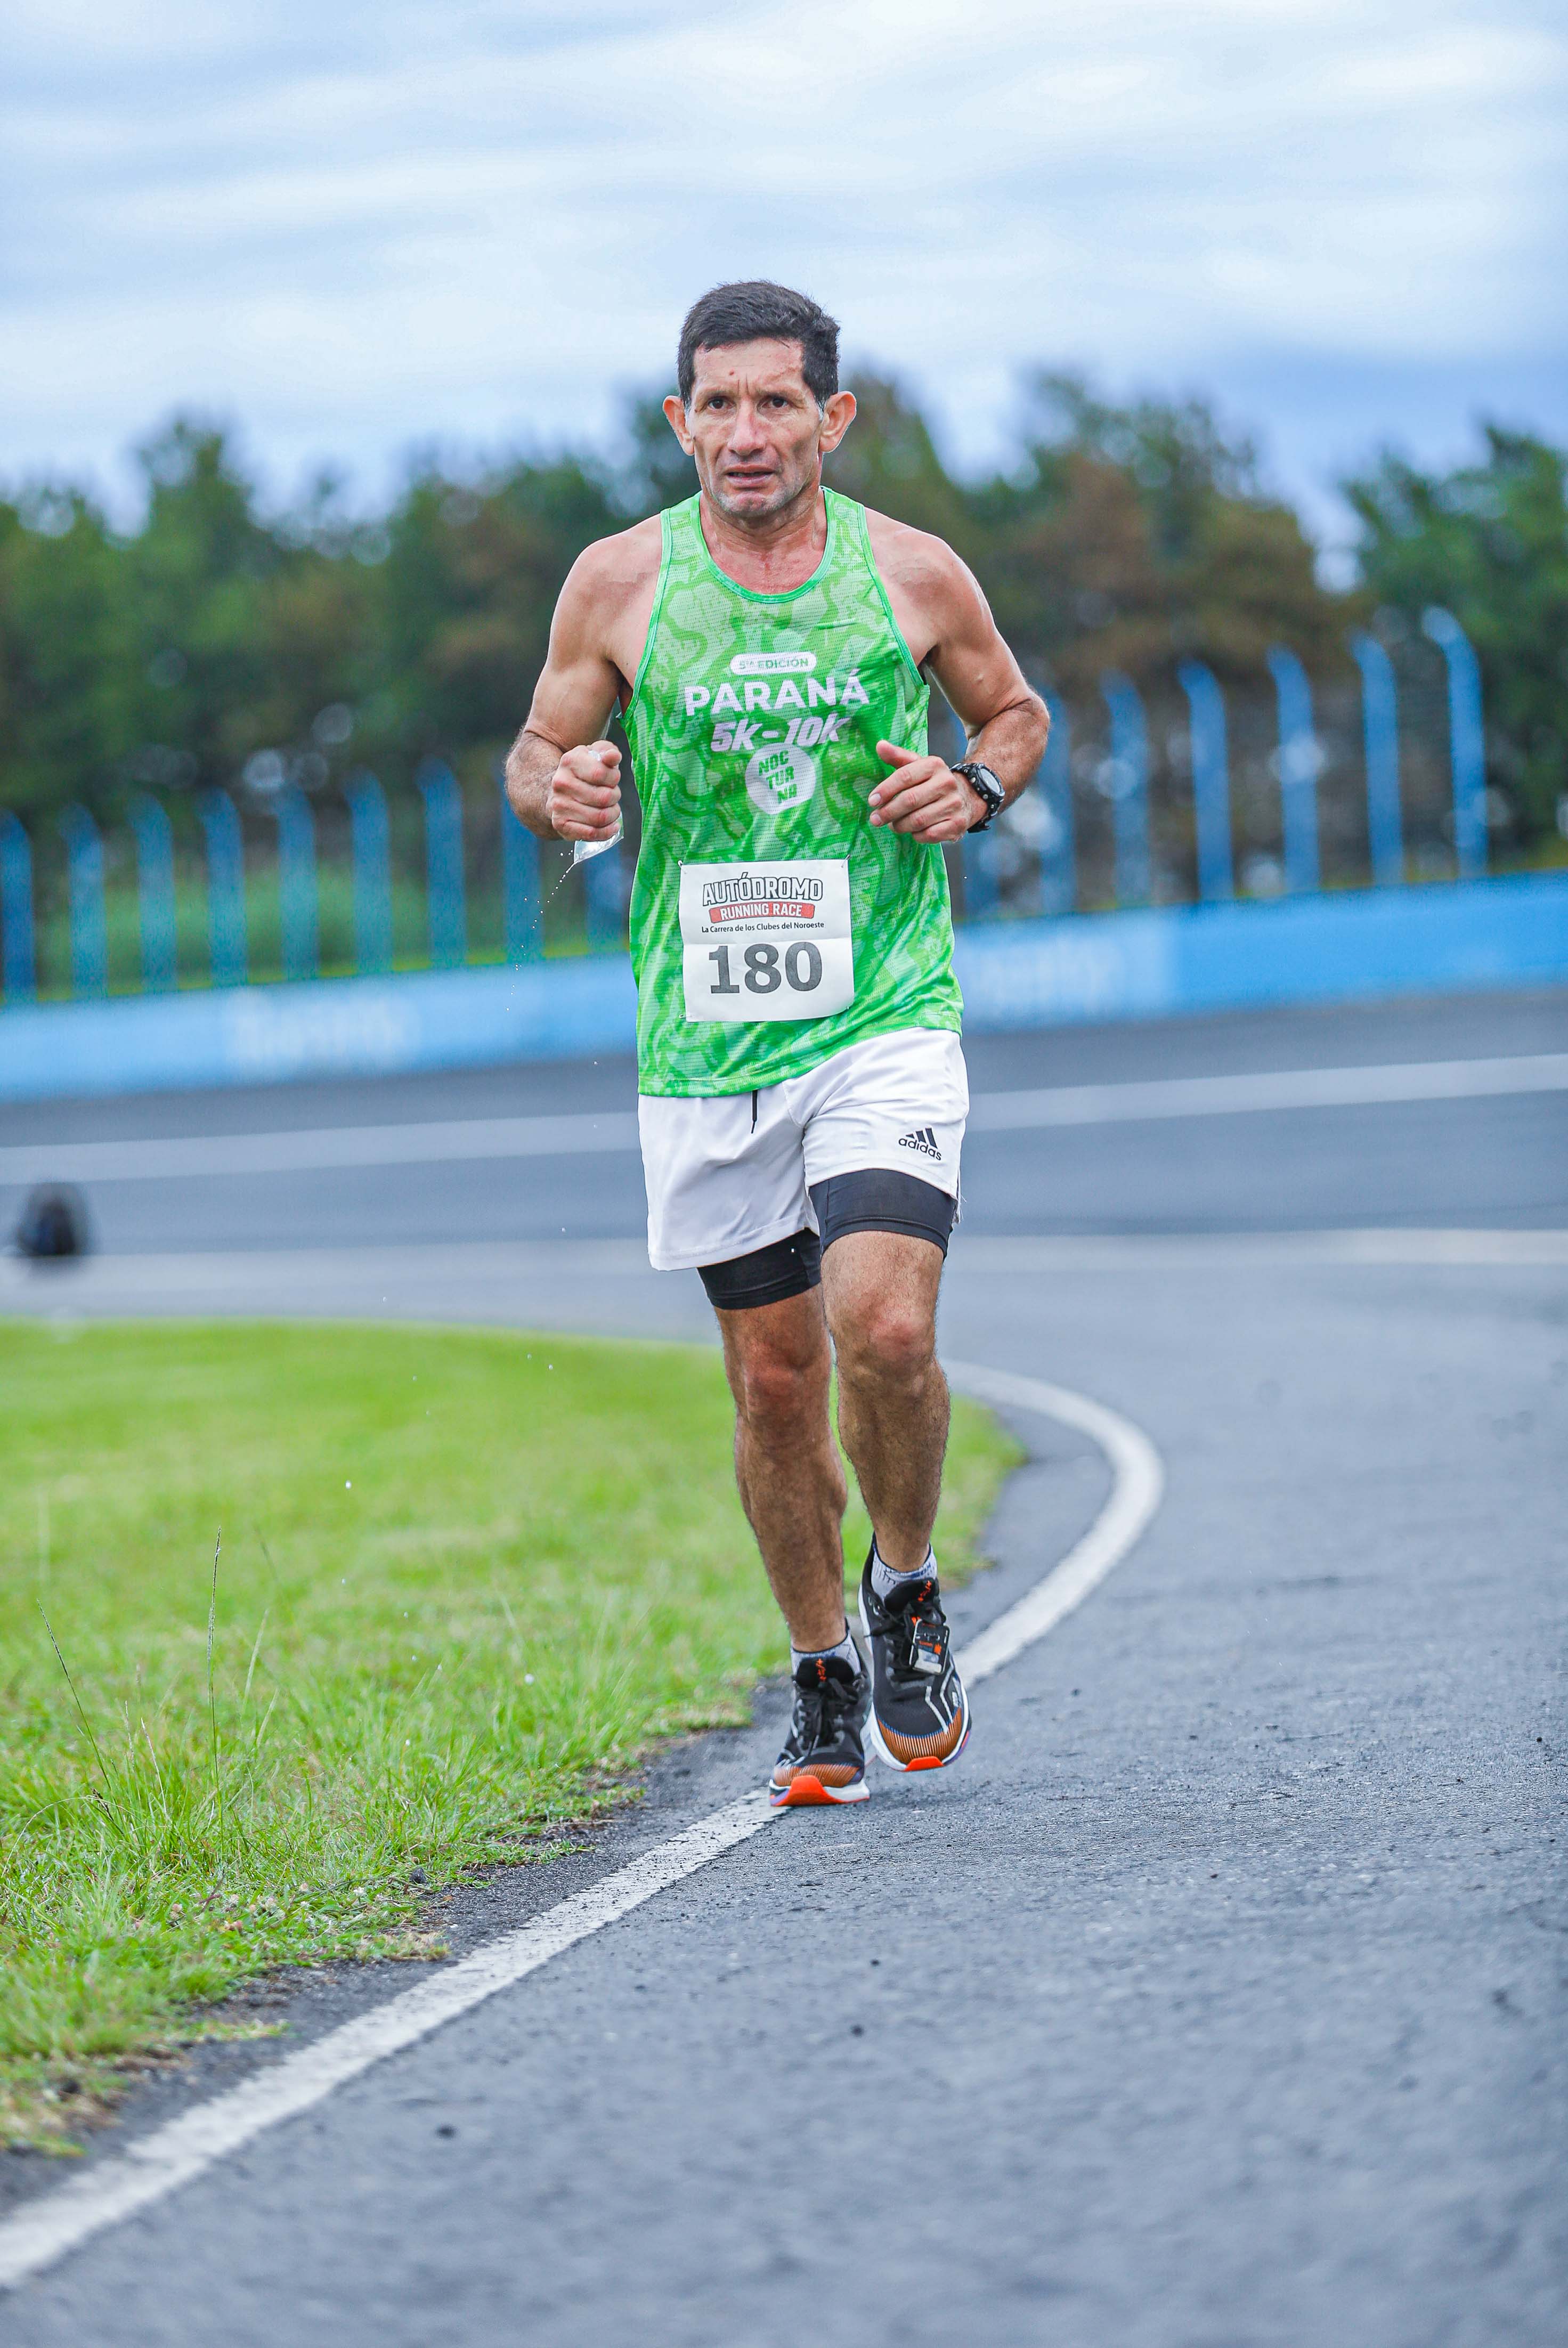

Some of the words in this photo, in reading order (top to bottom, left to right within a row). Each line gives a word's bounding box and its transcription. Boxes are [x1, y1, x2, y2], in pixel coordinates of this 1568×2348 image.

[684, 668, 870, 717] PARANÁ
[758, 750, 789, 776] NOC
[702, 872, 823, 906] AUTÓDROMO
[720, 904, 769, 920] RUNNING
[773, 904, 802, 917] RACE
[709, 941, 823, 994] 180
[898, 1138, 941, 1160] adidas
